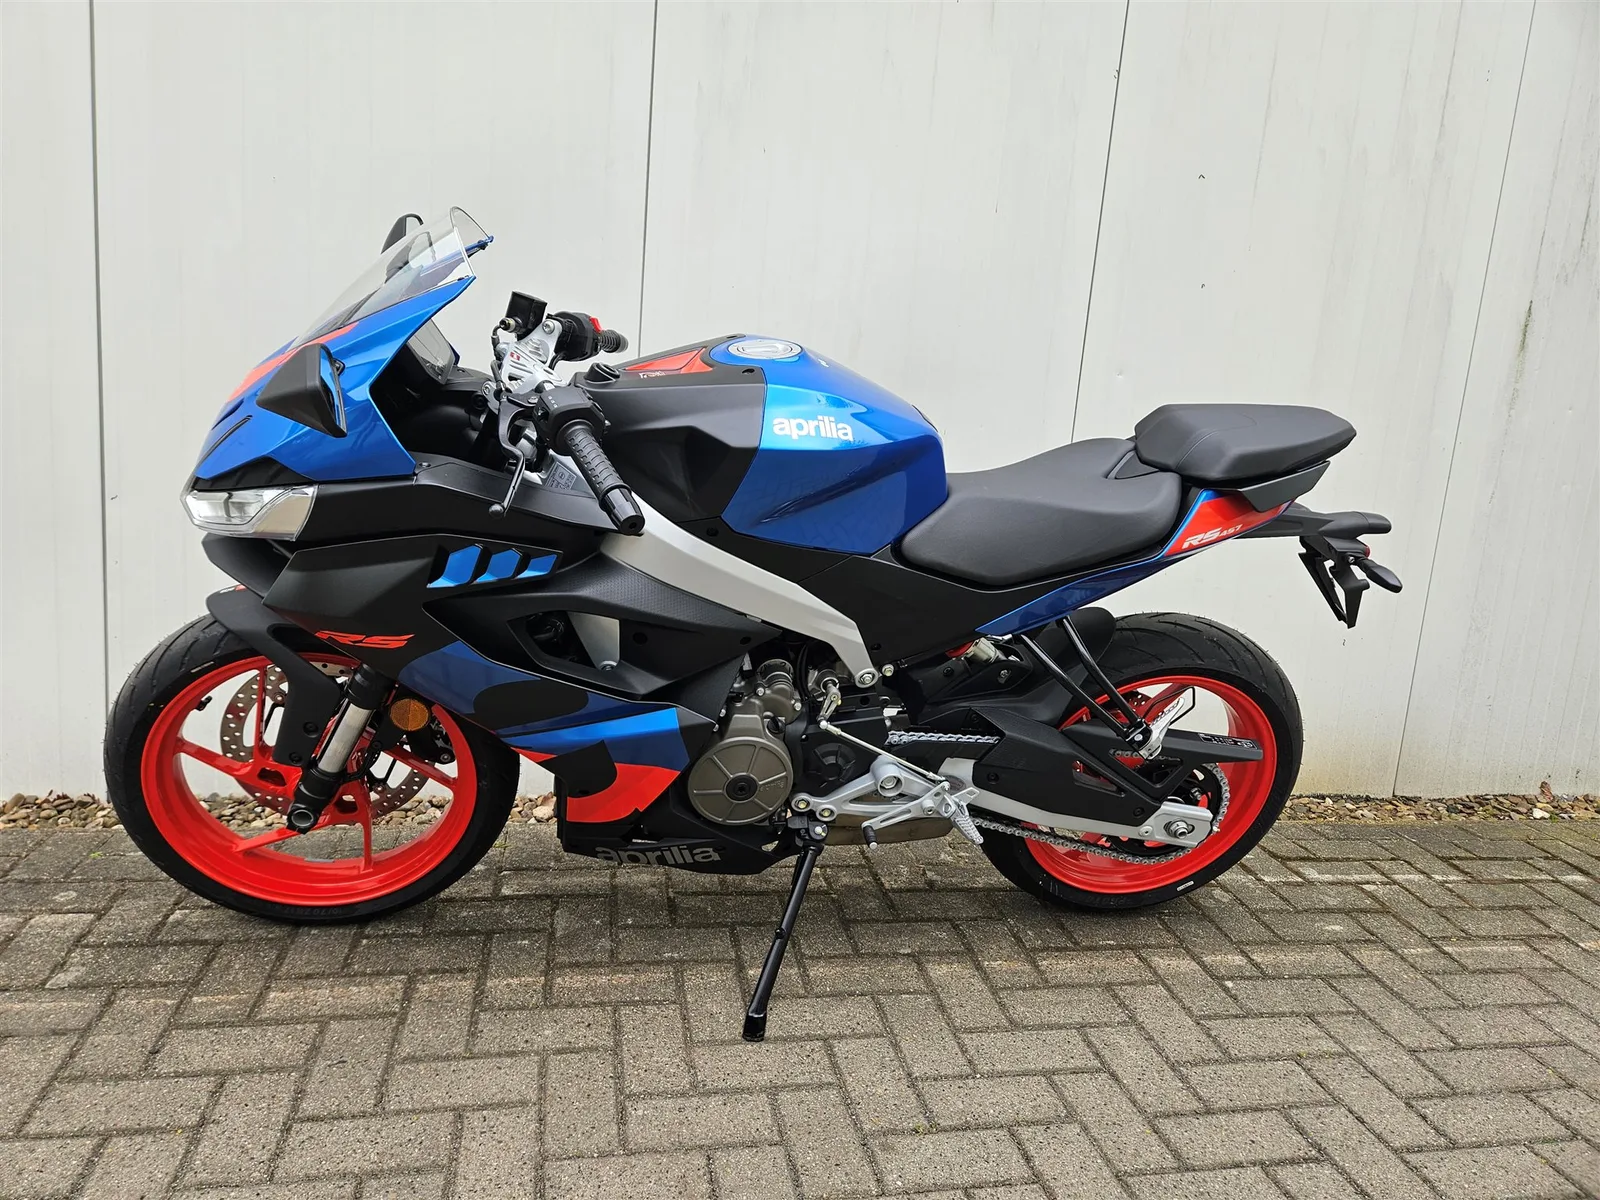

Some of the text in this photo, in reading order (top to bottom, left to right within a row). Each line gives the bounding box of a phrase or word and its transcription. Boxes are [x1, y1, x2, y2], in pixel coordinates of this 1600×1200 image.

[773, 415, 854, 441] aprilia
[1182, 524, 1243, 549] RS 457
[315, 629, 415, 649] RS
[595, 845, 721, 866] aprilia
